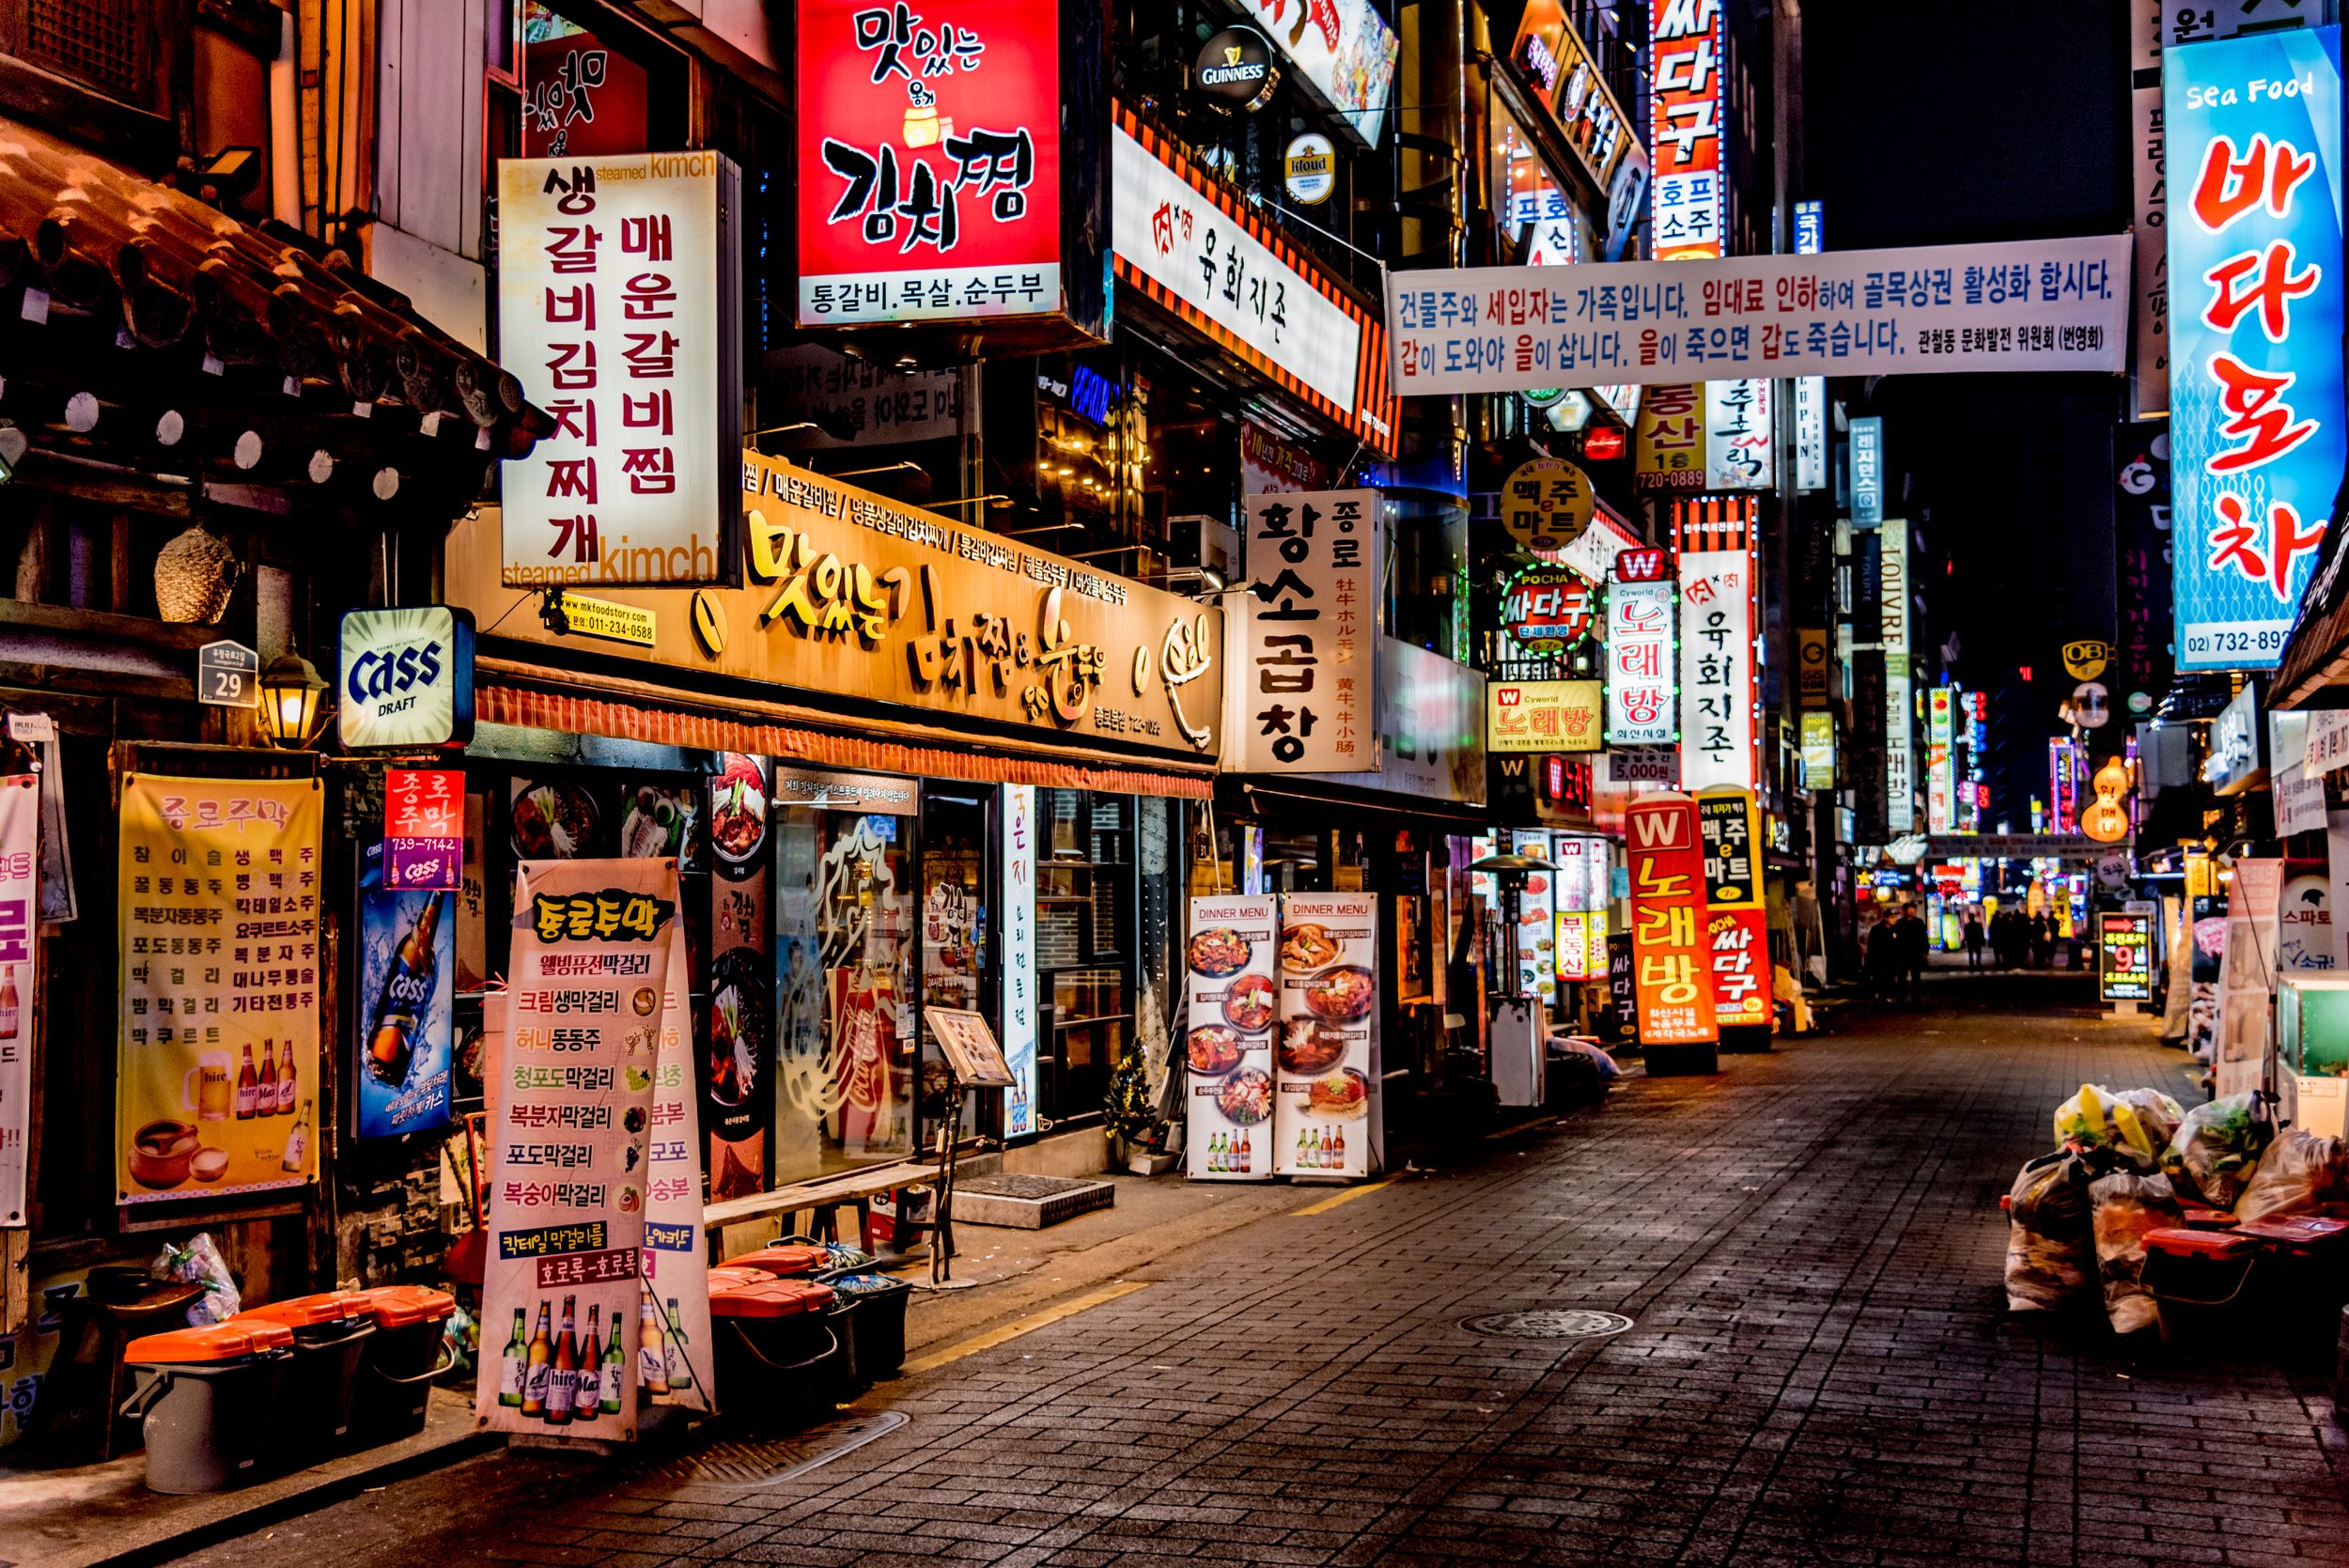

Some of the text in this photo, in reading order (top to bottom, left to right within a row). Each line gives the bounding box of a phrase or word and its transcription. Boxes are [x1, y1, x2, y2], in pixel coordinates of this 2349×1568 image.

[853, 2, 987, 85] 맛있는
[1201, 63, 1266, 85] GUINNESS
[1655, 0, 1719, 165] 싸다구
[2186, 71, 2314, 110] Sea Food
[596, 163, 646, 182] steamed
[1290, 156, 1327, 174] Kloud
[821, 127, 1035, 255] 김치찜
[1659, 177, 1713, 209] 호프
[1661, 208, 1713, 241] 소주
[1198, 227, 1286, 345] 육회지존
[1399, 258, 2113, 329] 건물주와 세입자는 가족입니다. 임대료 인하하여 골목상권 활성화 합시다.
[620, 213, 681, 496] 매운갈비찜
[1400, 318, 2104, 378] 갑이 도와야 을이 삽니다. 을이 죽으면 갑도 죽습니다. 관철동 문화발전 위원회 (번영회)
[542, 165, 603, 564] 생갈비김치찌개
[2188, 133, 2328, 604] 바다포차
[1644, 383, 1702, 450] 동산
[1640, 470, 1704, 489] 720-0889
[1512, 480, 1579, 506] 맥주
[774, 473, 838, 518] 매운갈비찜
[849, 497, 948, 554] 명품생갈비김치찌개
[1513, 510, 1578, 536] 마트
[1330, 501, 1362, 568] 종로
[503, 562, 592, 585] steamed
[746, 508, 887, 641] 맛있는
[1623, 552, 1657, 579] W
[1520, 574, 1569, 586] POCHA
[1619, 588, 1654, 598] Cyworld
[1503, 587, 1592, 629] 싸다구
[1254, 502, 1322, 764] 황소곱창
[2187, 636, 2210, 653] 02)
[1614, 598, 1671, 726] 노래방
[2066, 644, 2104, 662] OB
[215, 672, 242, 699] 29
[1501, 691, 1559, 704] W Cyworld
[1696, 610, 1735, 764] 육회지존
[378, 695, 417, 717] DRAFT
[1495, 706, 1594, 737] 노래방
[1501, 759, 1524, 777] W
[394, 772, 452, 804] 종로
[161, 796, 290, 832] 종로주막
[395, 805, 458, 836] 주막
[1633, 811, 1680, 848] W
[1700, 817, 1748, 846] 맥주
[133, 846, 223, 866] 참이슬
[235, 846, 315, 867] 생맥주
[391, 837, 457, 851] 739-7142
[1563, 843, 1579, 854] W
[1719, 843, 1733, 859] e
[235, 871, 315, 892] 병맥주
[1703, 857, 1751, 885] 마트
[133, 907, 223, 925] 복분자동동주
[235, 895, 315, 915] 칵테일소주
[1198, 907, 1268, 919] DINNER MENU
[1293, 904, 1368, 915] DINNER MENU
[235, 919, 316, 940] 요쿠르트소주
[1635, 857, 1702, 1004] 노래방
[132, 937, 222, 955] 포도동동주
[234, 943, 316, 963] 복분자주
[1561, 916, 1585, 978] 부동산
[132, 967, 220, 986] 막걸리
[538, 954, 651, 976] 웰빙퓨전막걸리
[1015, 906, 1026, 1027] 요리전문점
[1711, 926, 1758, 1001] 싸다구
[233, 967, 315, 988] 대나무통술
[1611, 954, 1636, 1022] 싸다구
[132, 997, 220, 1015] 밤막걸리
[232, 991, 315, 1013] 기타전통주
[518, 990, 620, 1014] 크림생막걸리
[516, 1027, 601, 1052] 허니동동주
[204, 1072, 227, 1083] hite
[513, 1065, 615, 1091] 청포도막걸리
[508, 1104, 613, 1130] 복분자막걸리
[506, 1143, 593, 1169] 포도막걸리
[503, 1181, 607, 1209] 복숭아막걸리
[502, 1223, 604, 1254] 칵테일 막걸리를
[540, 1250, 638, 1286] 호로록-호로록
[550, 1368, 576, 1387] hite
[575, 1371, 600, 1394] Max
